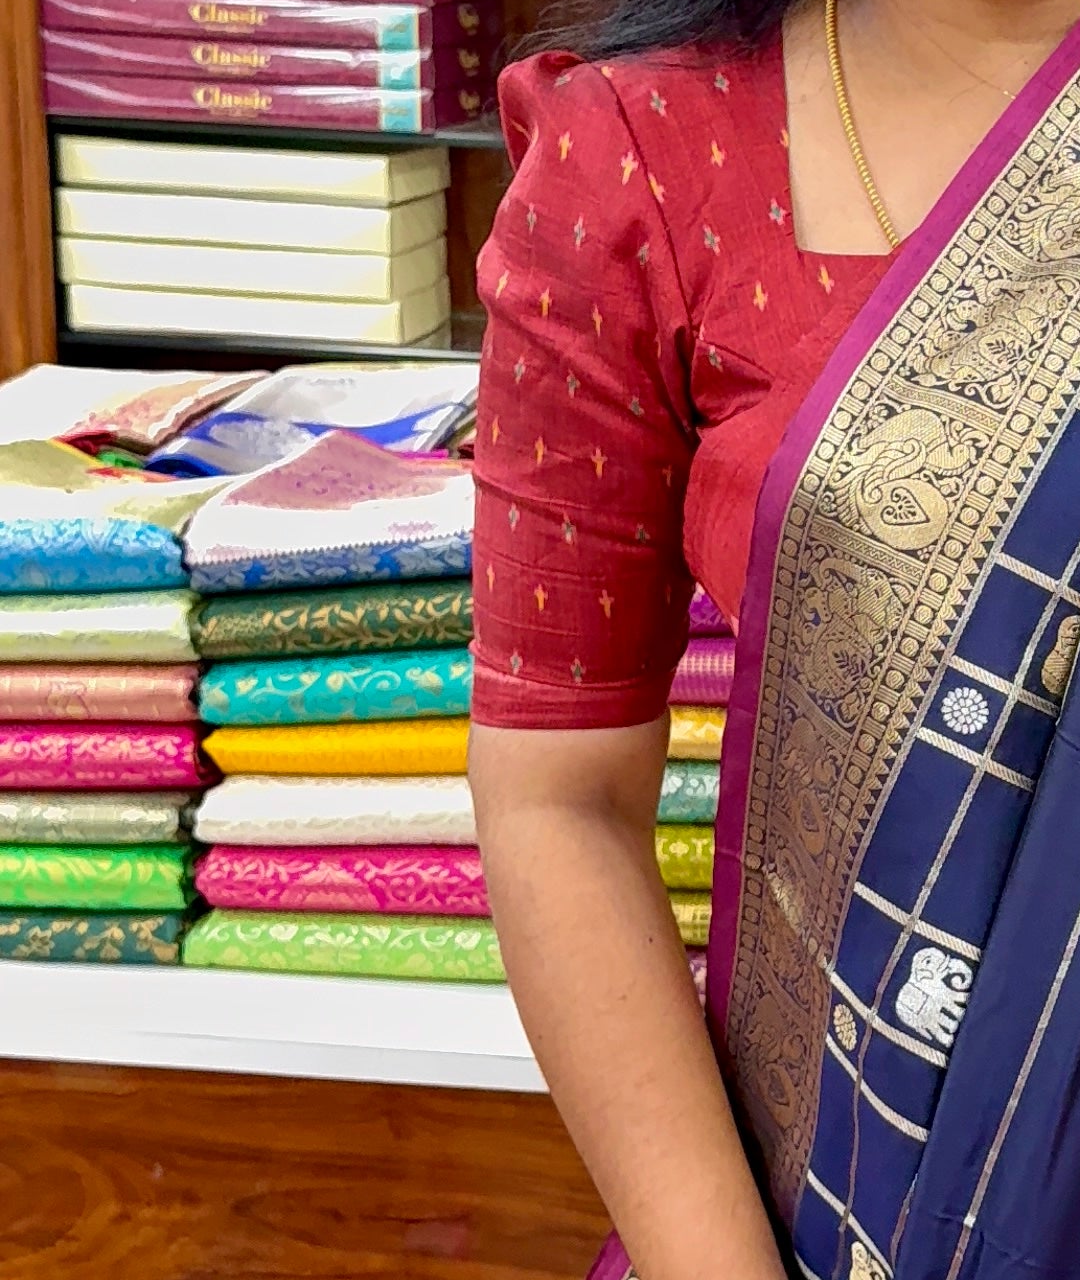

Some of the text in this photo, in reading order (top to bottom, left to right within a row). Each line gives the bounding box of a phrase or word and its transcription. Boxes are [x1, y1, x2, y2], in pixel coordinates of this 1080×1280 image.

[188, 2, 269, 26] Classic
[191, 42, 271, 68] Classic
[192, 84, 272, 110] Classic
